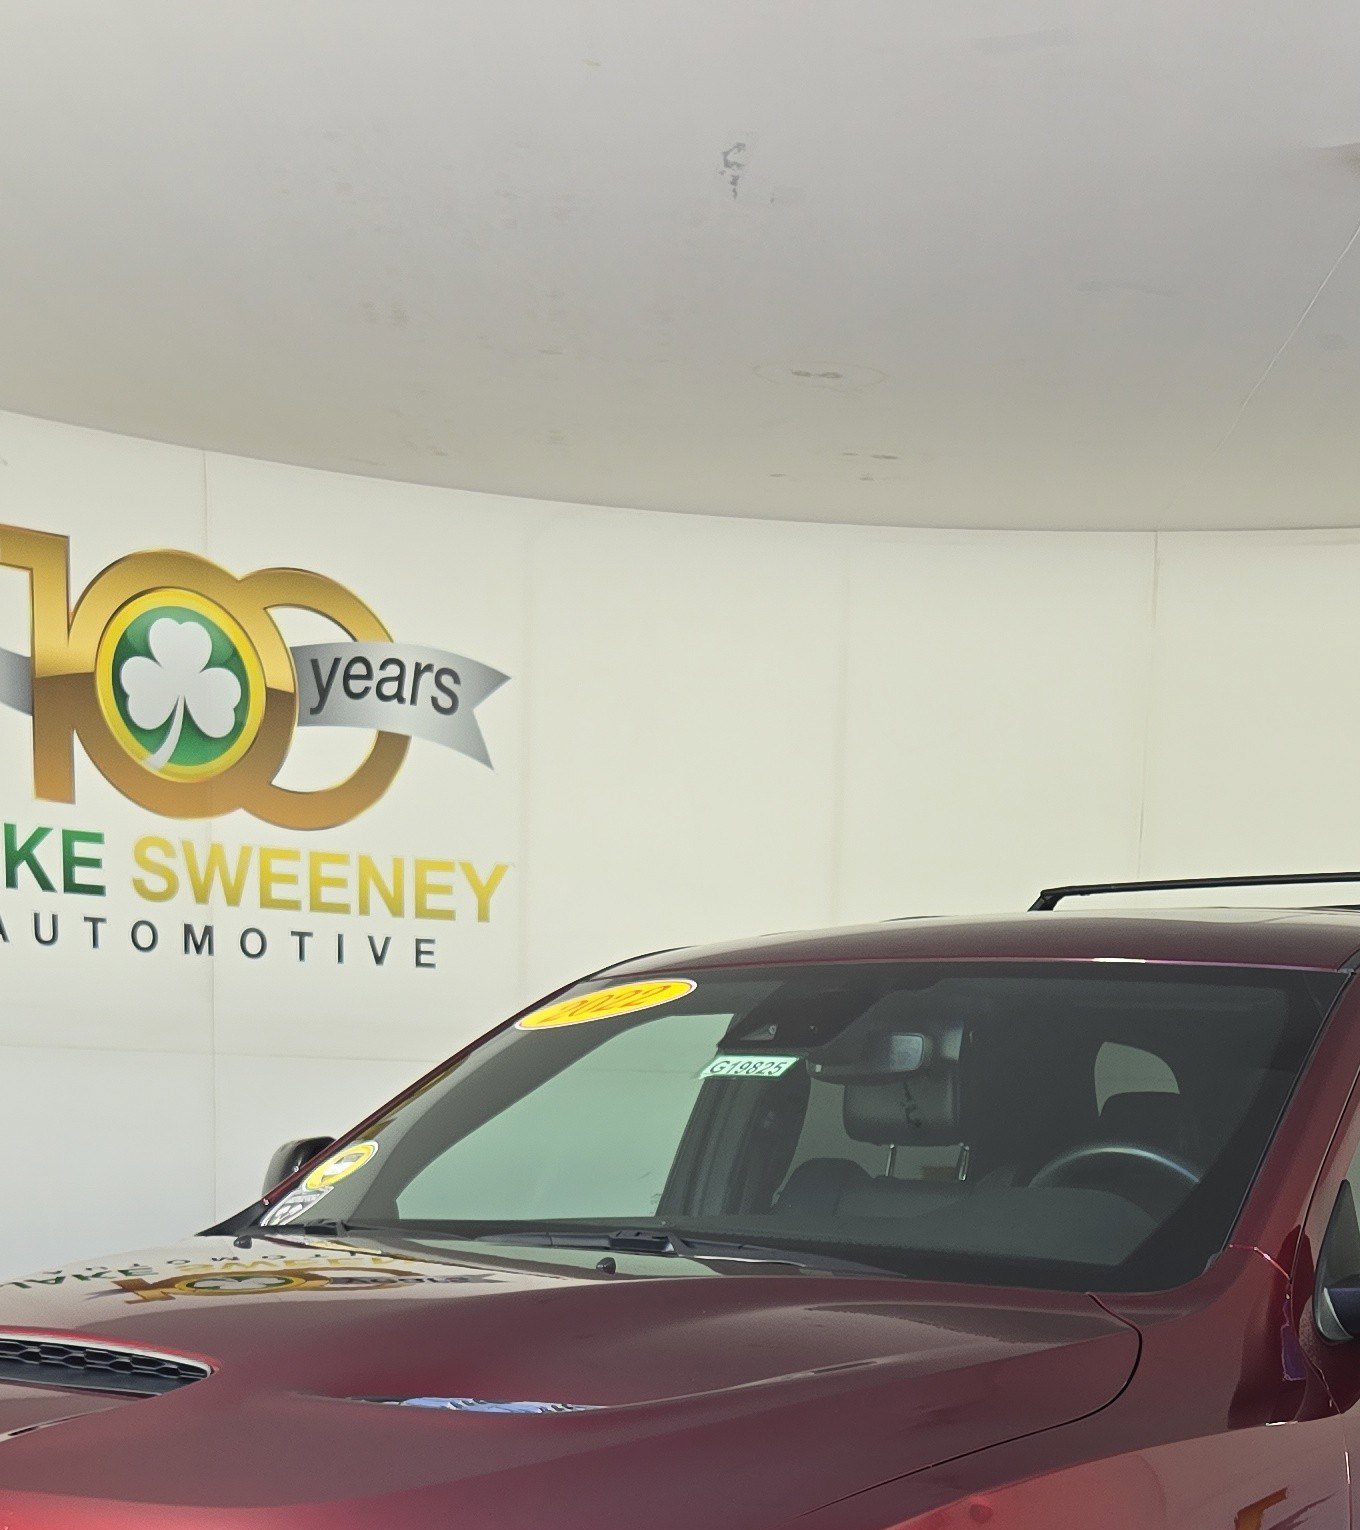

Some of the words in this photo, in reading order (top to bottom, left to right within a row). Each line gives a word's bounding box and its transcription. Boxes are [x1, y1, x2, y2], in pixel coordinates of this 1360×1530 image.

[307, 653, 462, 716] years
[131, 835, 508, 923] SWEENEY
[709, 1059, 788, 1076] G19825
